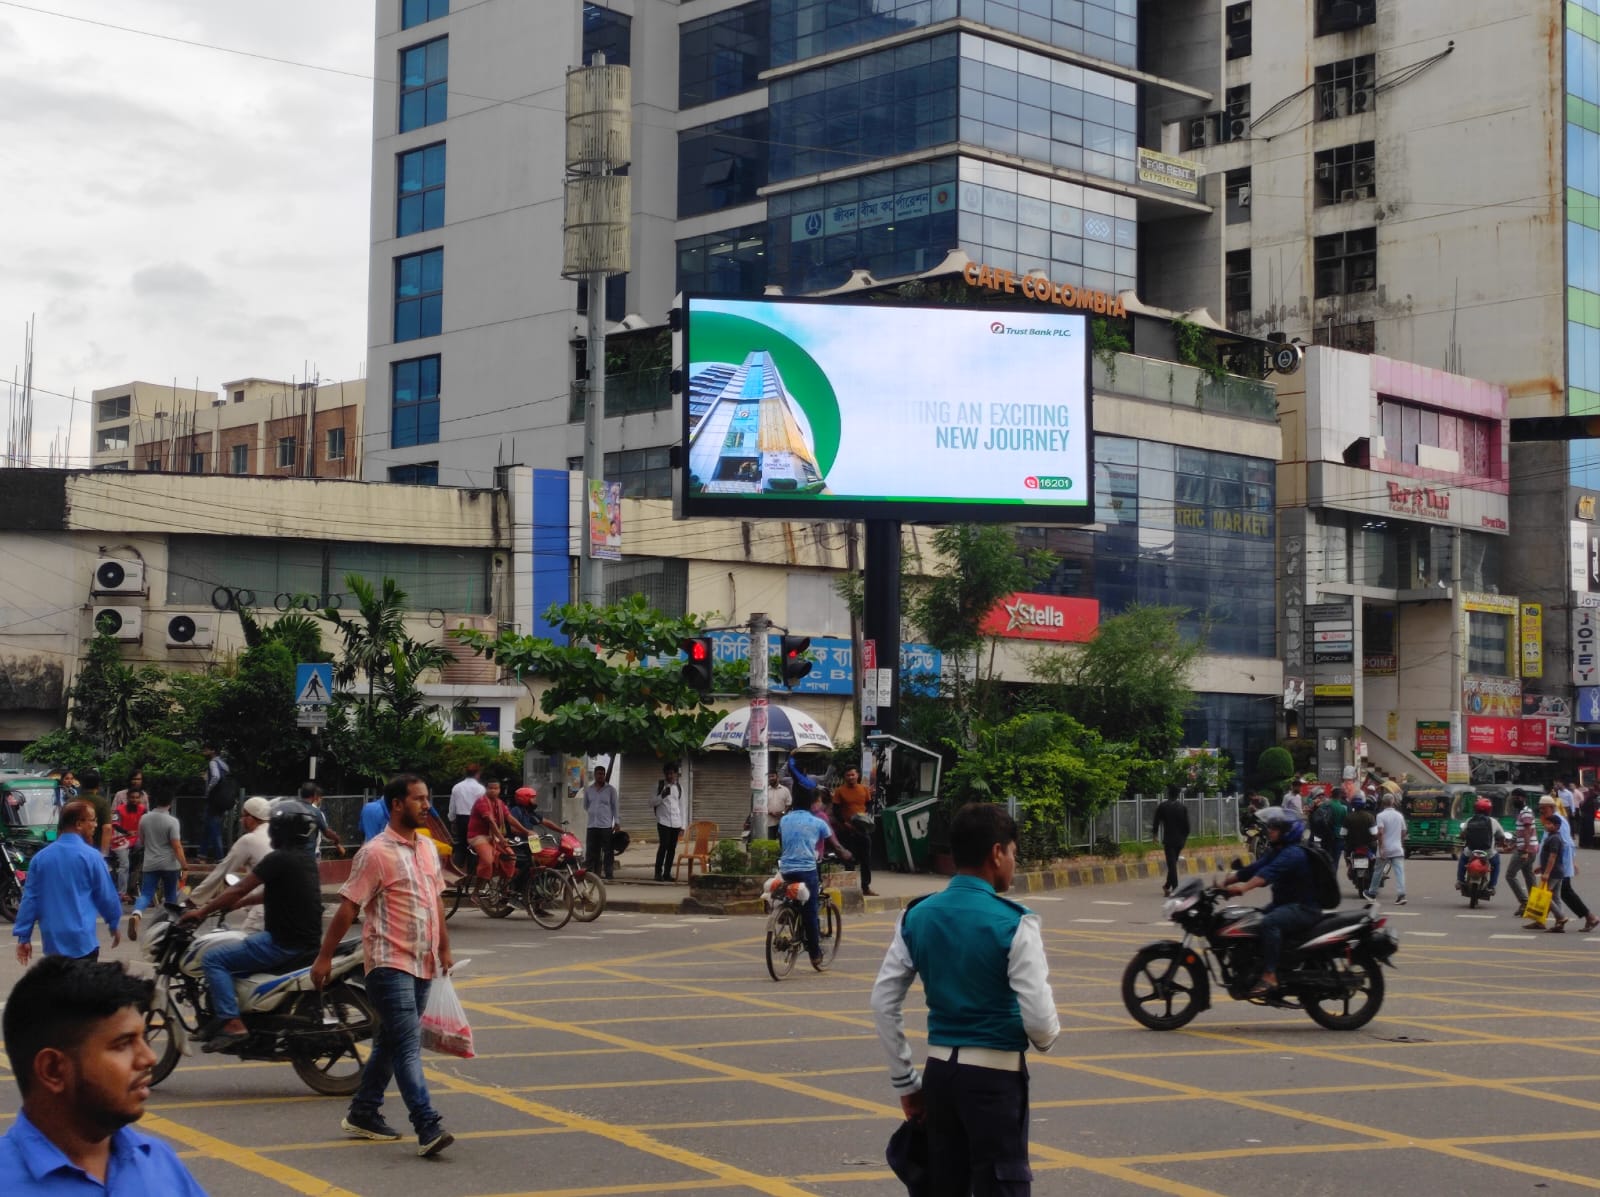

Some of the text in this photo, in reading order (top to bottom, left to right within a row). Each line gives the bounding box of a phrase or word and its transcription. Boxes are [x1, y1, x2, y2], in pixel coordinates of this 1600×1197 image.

[1147, 160, 1192, 180] FOR RENT
[833, 206, 857, 223] জীবন
[861, 202, 878, 217] বীমা
[963, 261, 1127, 319] CAFE COLOMBIA
[1006, 327, 1028, 335] Trust
[1029, 328, 1052, 336] Bank
[957, 401, 982, 425] AN
[990, 402, 1069, 427] EXCITING
[936, 425, 1070, 452] NEW JOURNEY
[1040, 479, 1070, 488] 16201
[1213, 510, 1268, 536] MARKET
[1019, 603, 1064, 627] Stella
[710, 731, 745, 740] WALTON
[798, 732, 829, 740] WALTON
